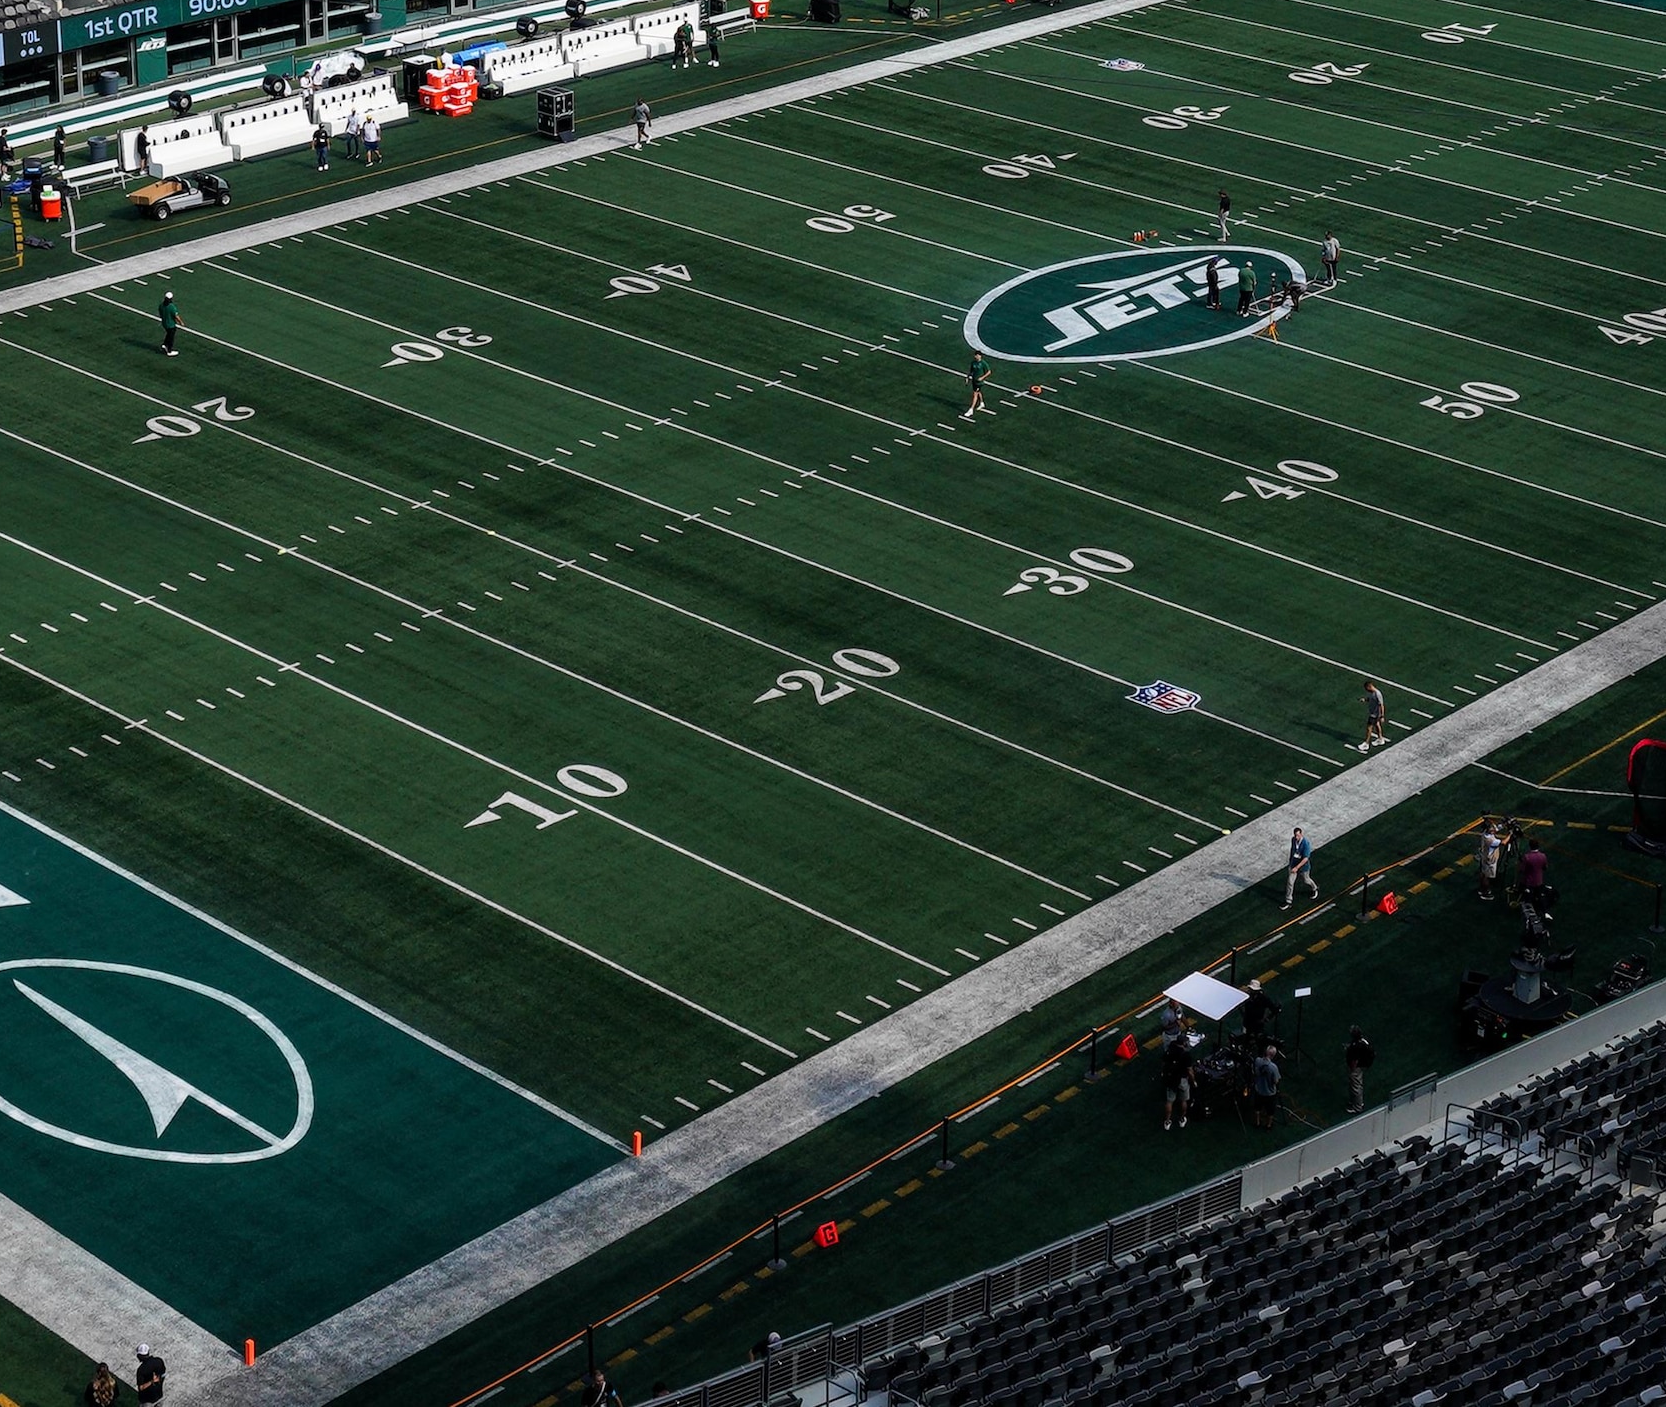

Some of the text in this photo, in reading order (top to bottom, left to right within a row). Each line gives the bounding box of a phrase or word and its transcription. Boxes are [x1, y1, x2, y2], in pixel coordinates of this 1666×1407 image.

[20, 30, 41, 44] TOL
[84, 17, 114, 39] 1st
[118, 5, 158, 34] QTR
[1421, 23, 1493, 44] 10
[1288, 61, 1362, 85] 20
[1142, 105, 1221, 130] 30
[982, 153, 1056, 179] 40
[806, 204, 896, 233] 50
[610, 264, 692, 294] 40
[1044, 256, 1243, 352] JETS
[391, 326, 492, 362] 30
[145, 396, 255, 437] 20
[1420, 381, 1521, 420] 50
[1245, 459, 1339, 501] 40
[1020, 547, 1135, 596] 30
[776, 648, 900, 705] 20
[1151, 688, 1195, 713] NFL
[487, 764, 628, 830] 10
